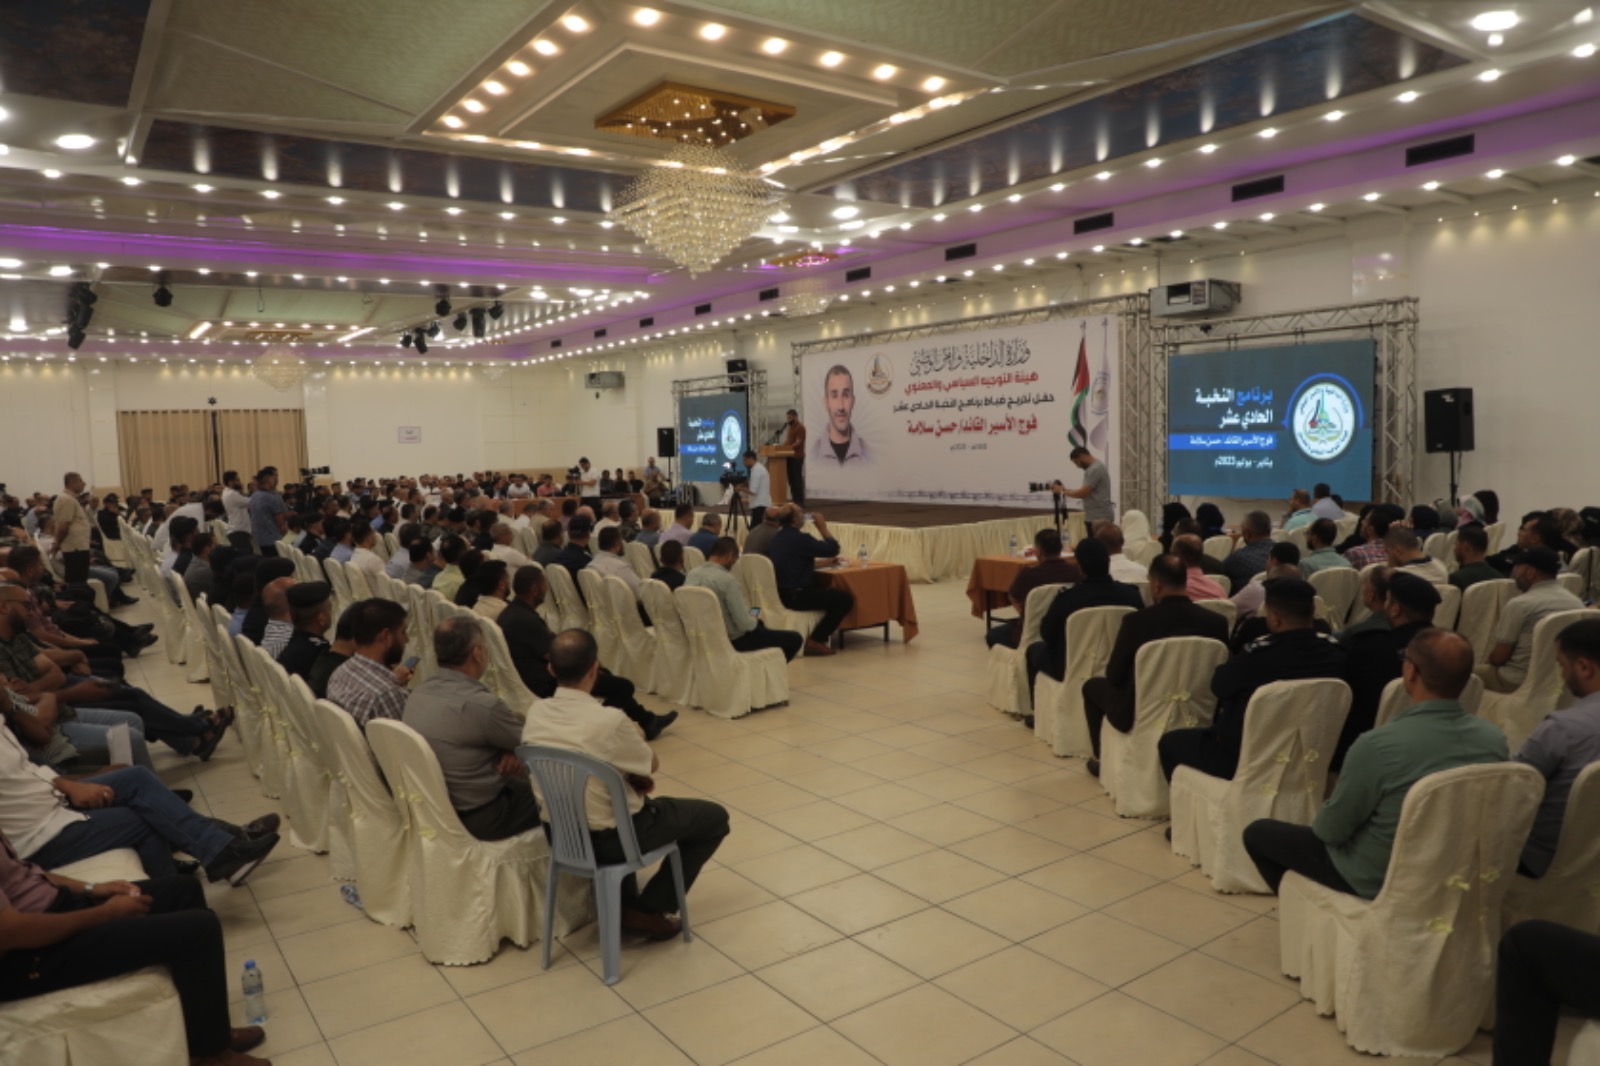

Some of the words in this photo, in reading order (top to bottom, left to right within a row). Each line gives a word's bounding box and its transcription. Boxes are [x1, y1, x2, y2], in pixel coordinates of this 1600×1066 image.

[943, 376, 980, 393] السياسي
[980, 373, 1014, 389] التوجيه
[1013, 370, 1040, 385] هيئة
[903, 380, 943, 396] والمعنوي
[1236, 386, 1274, 406] برنامج
[934, 399, 957, 411] النخبة
[957, 396, 984, 412] برنامج
[983, 395, 1007, 407] ضباط
[1007, 393, 1032, 410] تخريج
[1032, 391, 1055, 405] حفل
[1195, 387, 1235, 408] النخبة
[892, 402, 910, 414] عشر
[910, 399, 934, 413] الحادي
[988, 412, 1017, 435] الأسير
[1017, 412, 1038, 435] فوج
[1218, 407, 1240, 429] عشر
[1240, 408, 1273, 430] الحادي
[907, 420, 934, 434] سلامة
[934, 419, 958, 438] حسن
